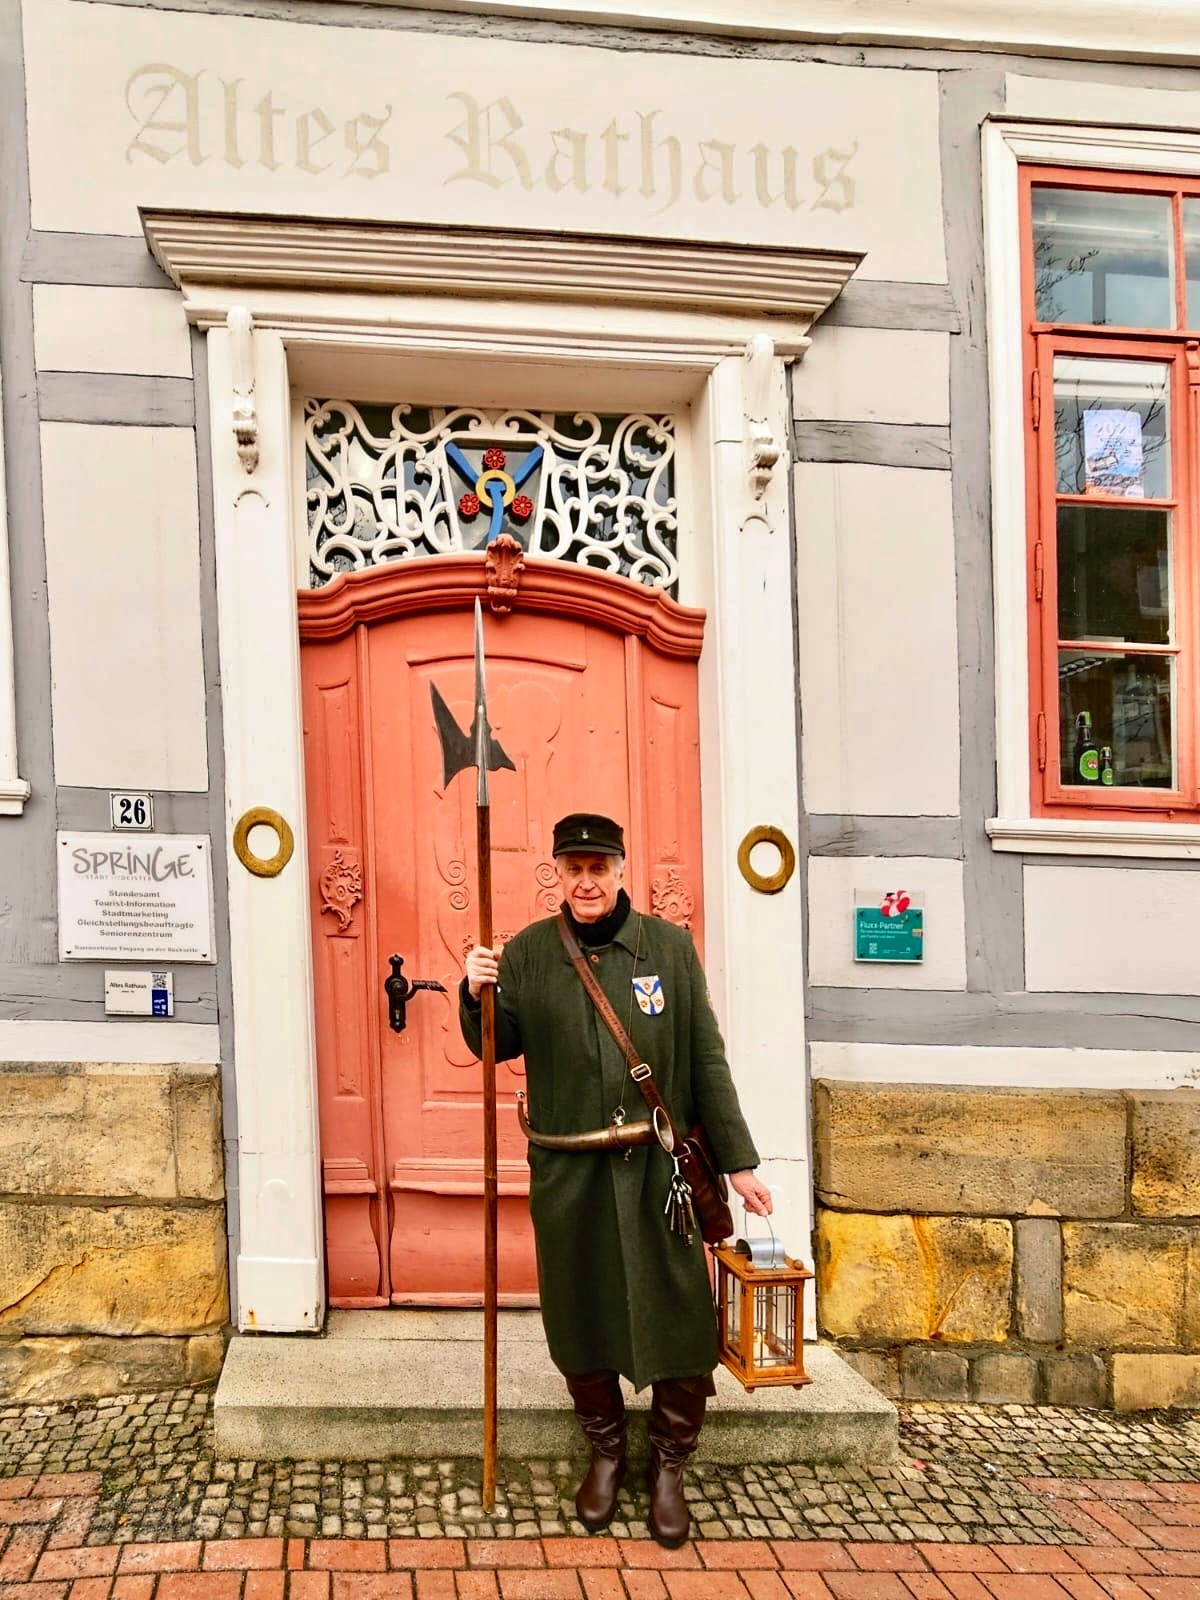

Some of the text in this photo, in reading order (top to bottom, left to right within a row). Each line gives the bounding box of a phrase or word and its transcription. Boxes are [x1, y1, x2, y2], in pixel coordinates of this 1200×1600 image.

[124, 64, 859, 216] Altes Rathaus
[120, 798, 146, 824] 26
[109, 890, 160, 898] Standesamt
[94, 899, 176, 908] Tourist-Information
[102, 909, 169, 919] Stadtmarketing
[77, 919, 194, 930] Gleichstellungsbeauftragte
[100, 929, 173, 938] Seniorenzentrum
